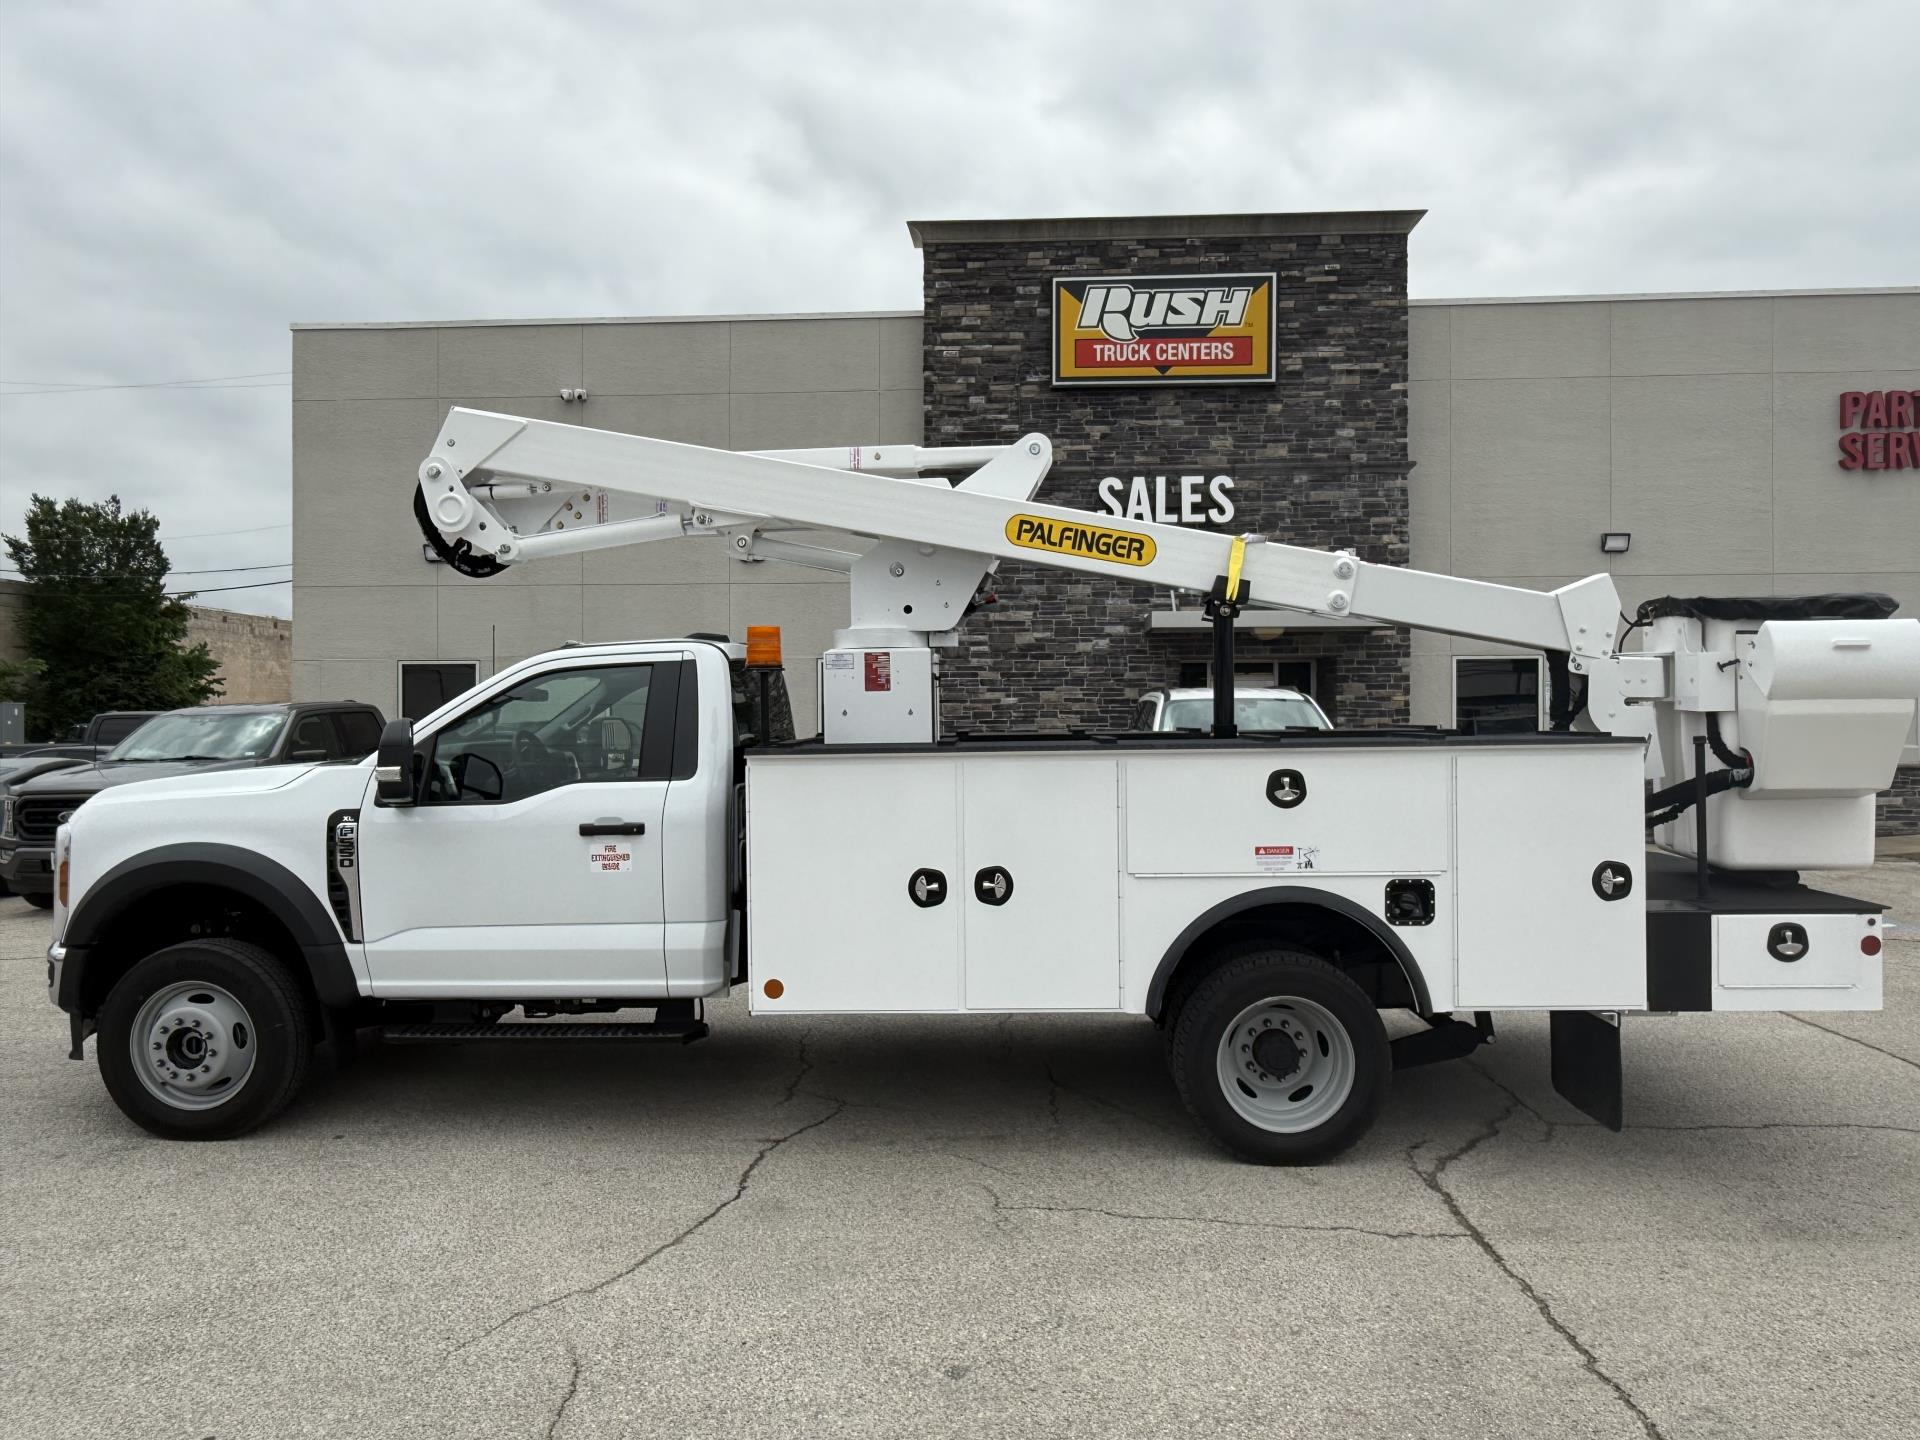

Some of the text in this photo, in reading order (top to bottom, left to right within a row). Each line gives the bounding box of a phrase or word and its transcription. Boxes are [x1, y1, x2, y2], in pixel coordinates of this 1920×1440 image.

[1076, 285, 1252, 343] RUSH
[1093, 342, 1234, 362] TRUCK CENTERS
[1097, 475, 1235, 524] SALES
[1016, 519, 1146, 561] PALFINGER
